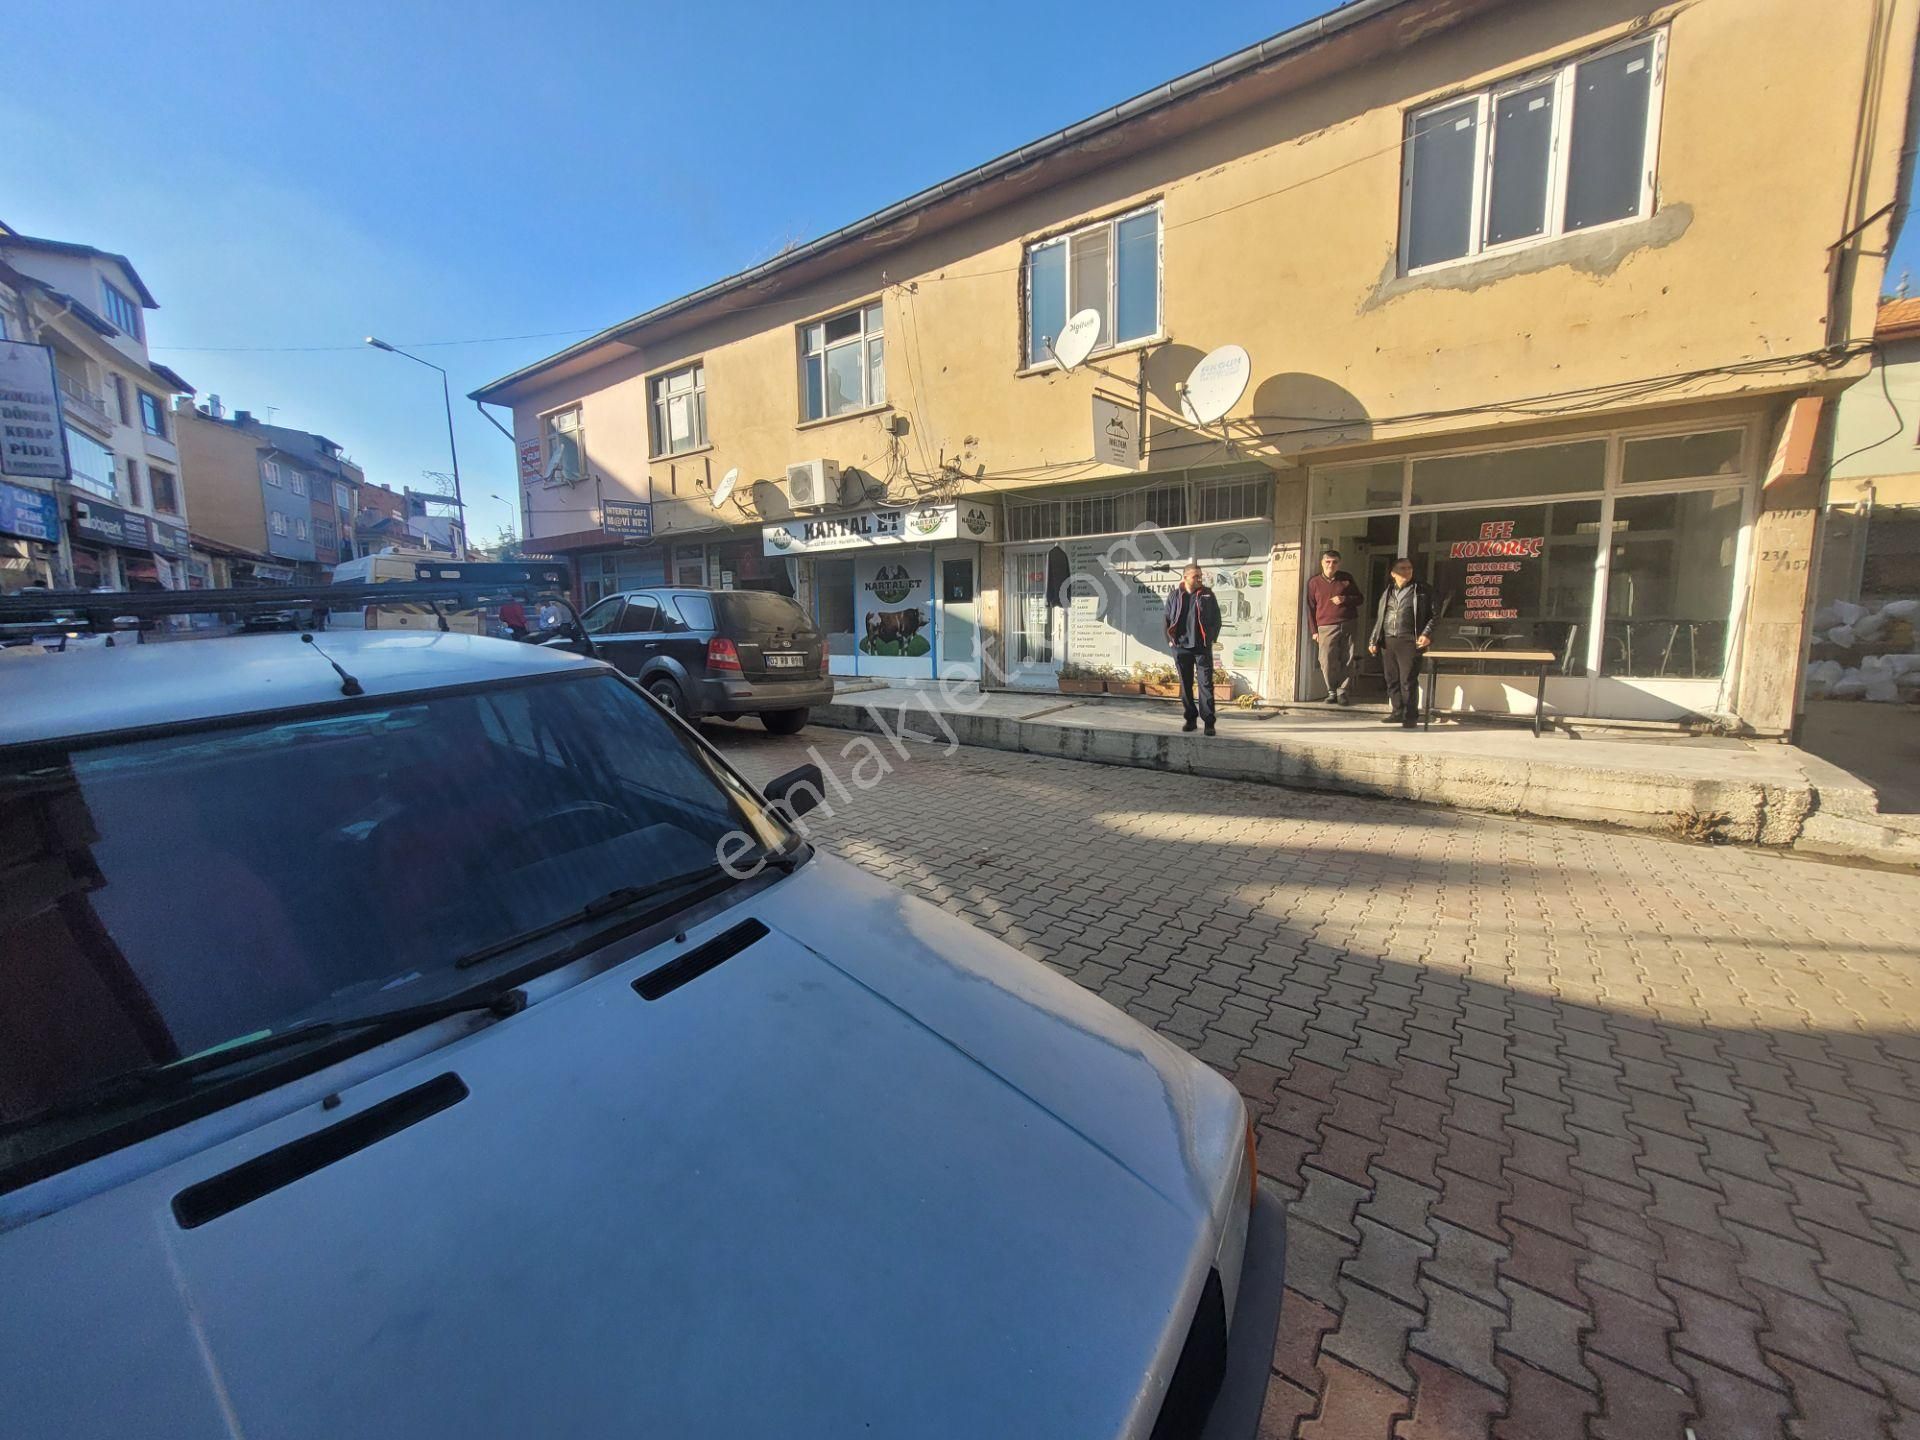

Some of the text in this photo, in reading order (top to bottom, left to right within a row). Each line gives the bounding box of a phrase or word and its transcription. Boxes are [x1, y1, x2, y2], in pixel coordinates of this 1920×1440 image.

[804, 511, 901, 540] KARTAL ET
[1479, 521, 1515, 540] EFE
[1450, 537, 1545, 558] KOKOREÇ
[1466, 562, 1521, 572] KOKOREÇ
[1466, 574, 1503, 584] KÖFTE
[865, 579, 922, 591] KARTAL ET
[1137, 584, 1176, 594] MELTEM
[1465, 599, 1502, 608] TAVUK
[1464, 609, 1518, 619] UYKULUK
